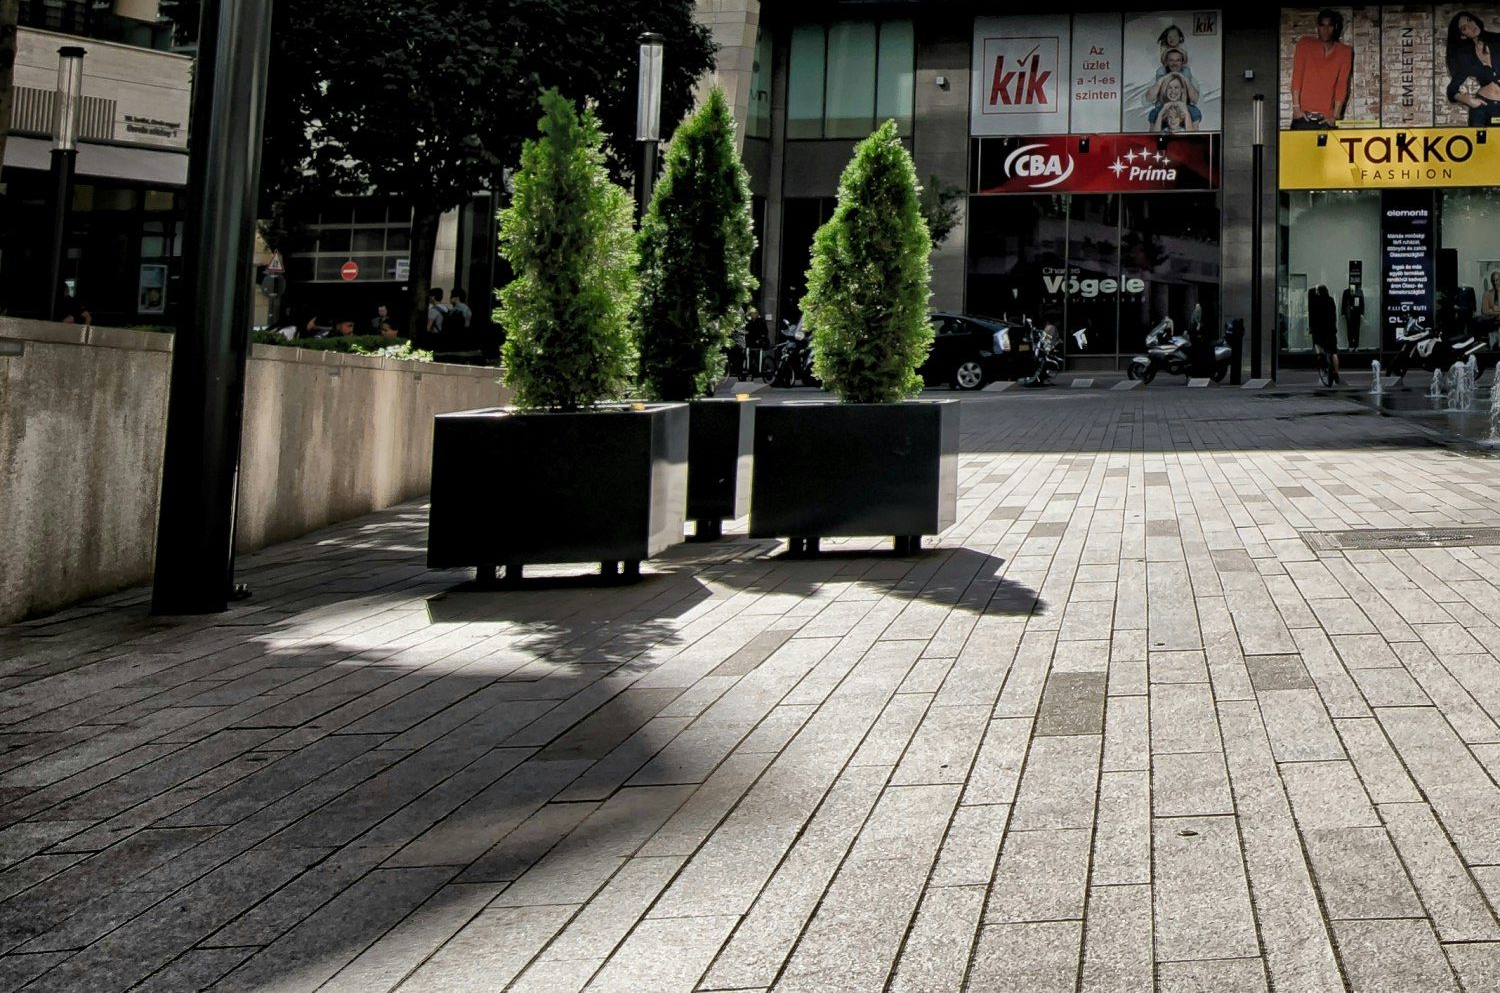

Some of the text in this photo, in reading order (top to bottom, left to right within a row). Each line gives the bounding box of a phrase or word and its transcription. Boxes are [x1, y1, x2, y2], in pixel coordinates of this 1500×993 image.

[1089, 46, 1105, 56] Az
[1082, 59, 1111, 71] üzlet
[1402, 27, 1414, 109] EMELETEN
[989, 45, 1053, 106] kik
[1076, 77, 1084, 86] a
[1075, 89, 1118, 101] szinten
[1340, 135, 1473, 164] TAKKO
[1015, 154, 1063, 177] CBA
[1360, 168, 1453, 181] FASHION
[1386, 209, 1428, 217] elements
[1042, 273, 1146, 298] Vögele
